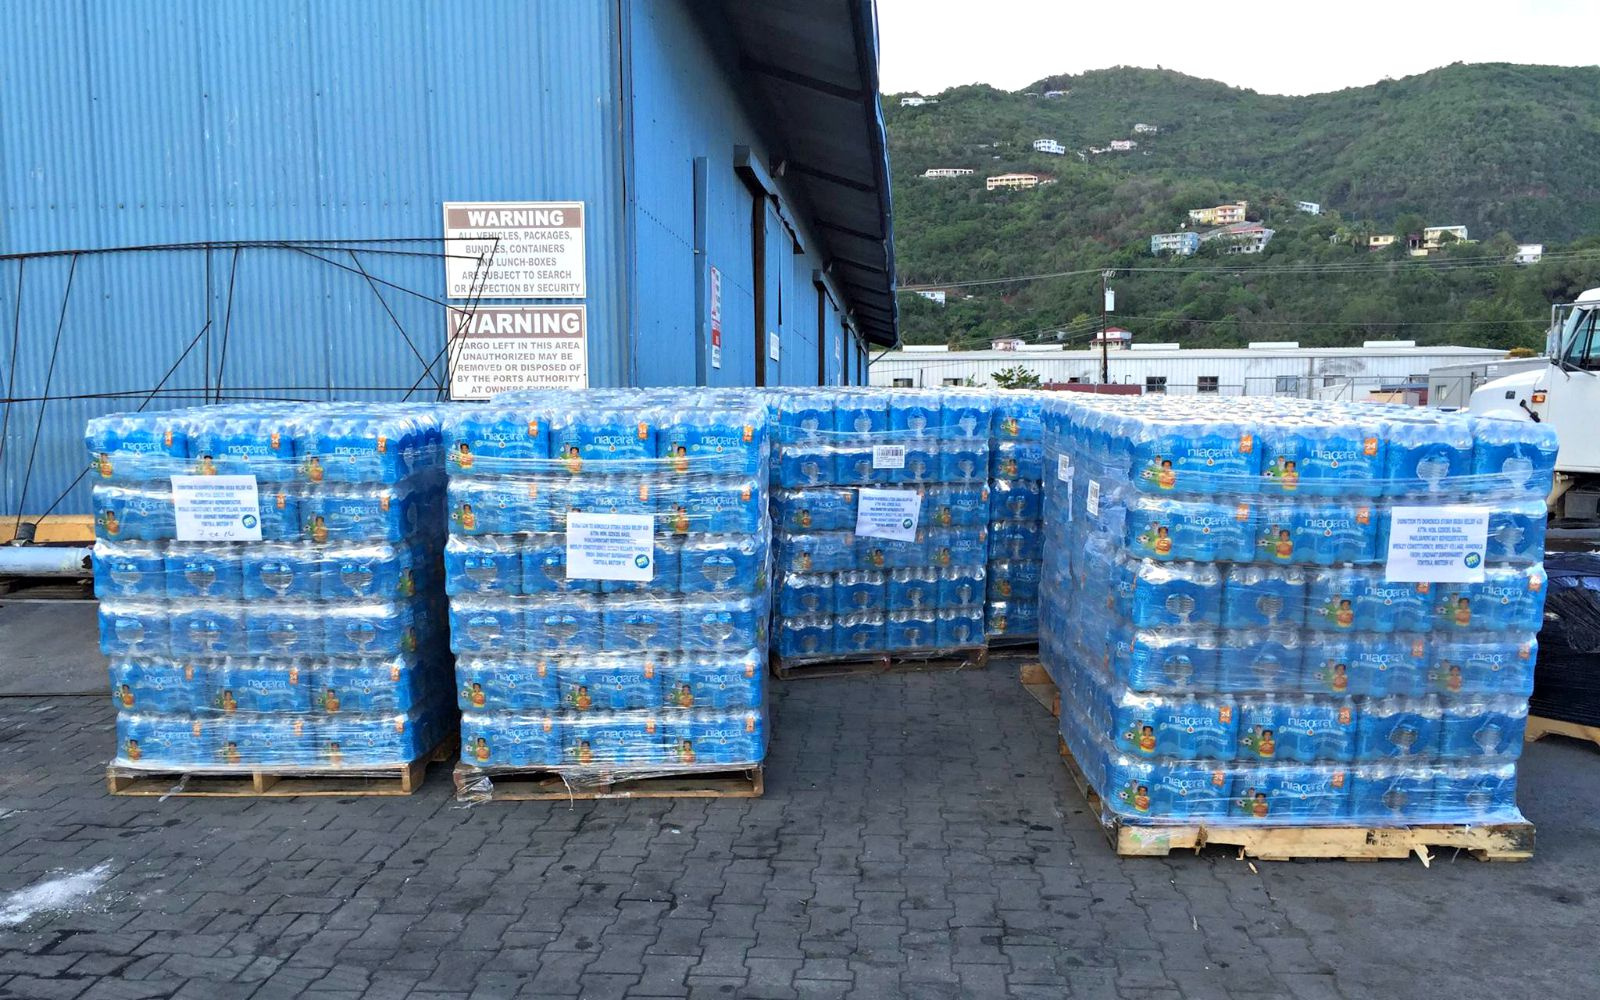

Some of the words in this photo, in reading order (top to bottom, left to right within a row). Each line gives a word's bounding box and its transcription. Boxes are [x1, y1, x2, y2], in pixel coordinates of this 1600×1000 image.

[467, 210, 564, 227] WARNING
[459, 232, 474, 240] ALL
[476, 232, 521, 241] VEHICLES,
[524, 231, 572, 241] PACKAGES,
[466, 245, 508, 254] BUNDLES,
[510, 244, 565, 253] CONTAINERS
[476, 258, 494, 267] AND
[497, 258, 557, 266] LUNCH-BOXES
[462, 271, 479, 280] ARE
[481, 271, 520, 280] SUBJECT
[523, 271, 535, 279] TO
[537, 270, 572, 279] SEARCH
[454, 284, 466, 293] OR
[469, 284, 521, 293] INSPECTION
[523, 284, 534, 292] BY
[537, 283, 580, 292] SECURITY
[453, 313, 580, 334] WARNING
[458, 342, 490, 350] CARGO
[493, 342, 515, 350] LEFT
[518, 342, 528, 350] IN
[530, 341, 552, 350] THIS
[555, 341, 580, 350] AREA
[463, 353, 535, 361] UNAUTHORIZED
[458, 364, 503, 372] REMOVED
[570, 363, 581, 371] OF
[457, 375, 471, 383] BY
[473, 375, 491, 383] THE
[493, 375, 524, 383] PORTS
[526, 374, 580, 383] AUTHORITY
[1187, 448, 1233, 465] niagara
[1310, 449, 1357, 467] niagara
[1183, 515, 1230, 533] niagara
[1305, 518, 1350, 536] niagara
[1365, 586, 1410, 604] niagara
[1169, 715, 1213, 732] niagara
[1288, 717, 1332, 734] niagara
[1163, 776, 1205, 795] niagara
[1281, 781, 1326, 798] niagara
